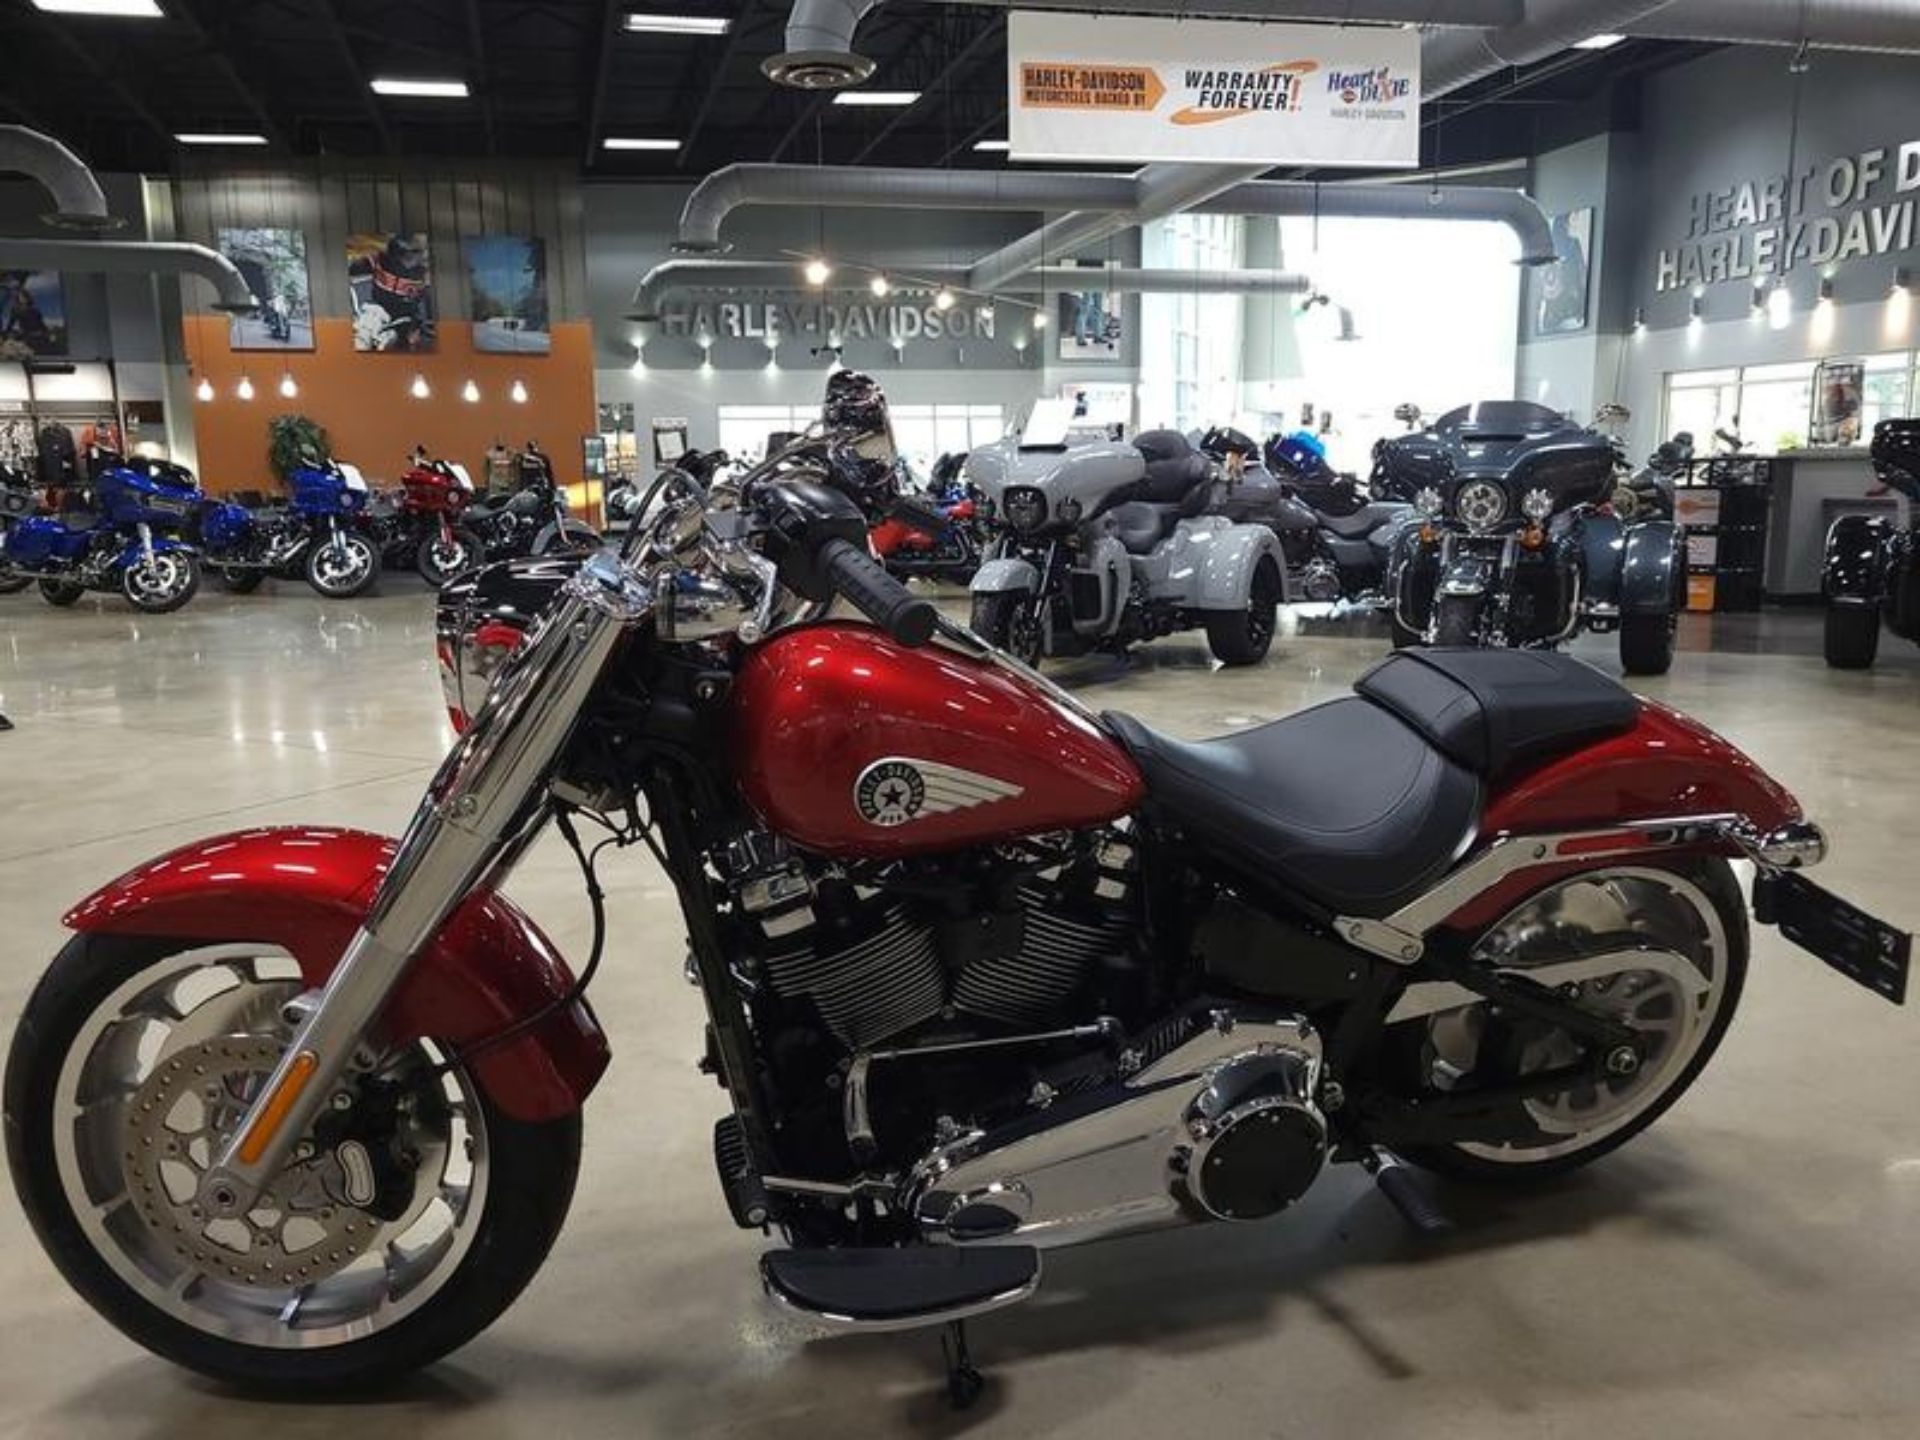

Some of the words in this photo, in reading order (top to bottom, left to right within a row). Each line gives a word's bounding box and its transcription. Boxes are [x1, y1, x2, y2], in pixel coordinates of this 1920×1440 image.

[1024, 69, 1145, 91] HARLEY-DAVIDSON
[1185, 70, 1294, 91] WARRANTY
[1327, 69, 1374, 92] Heart
[1687, 167, 1814, 238] HEART
[1822, 149, 1886, 208] OF
[1656, 200, 1915, 292] HARLEY-DAVI
[660, 303, 995, 340] HARLEY-DAVIDSON
